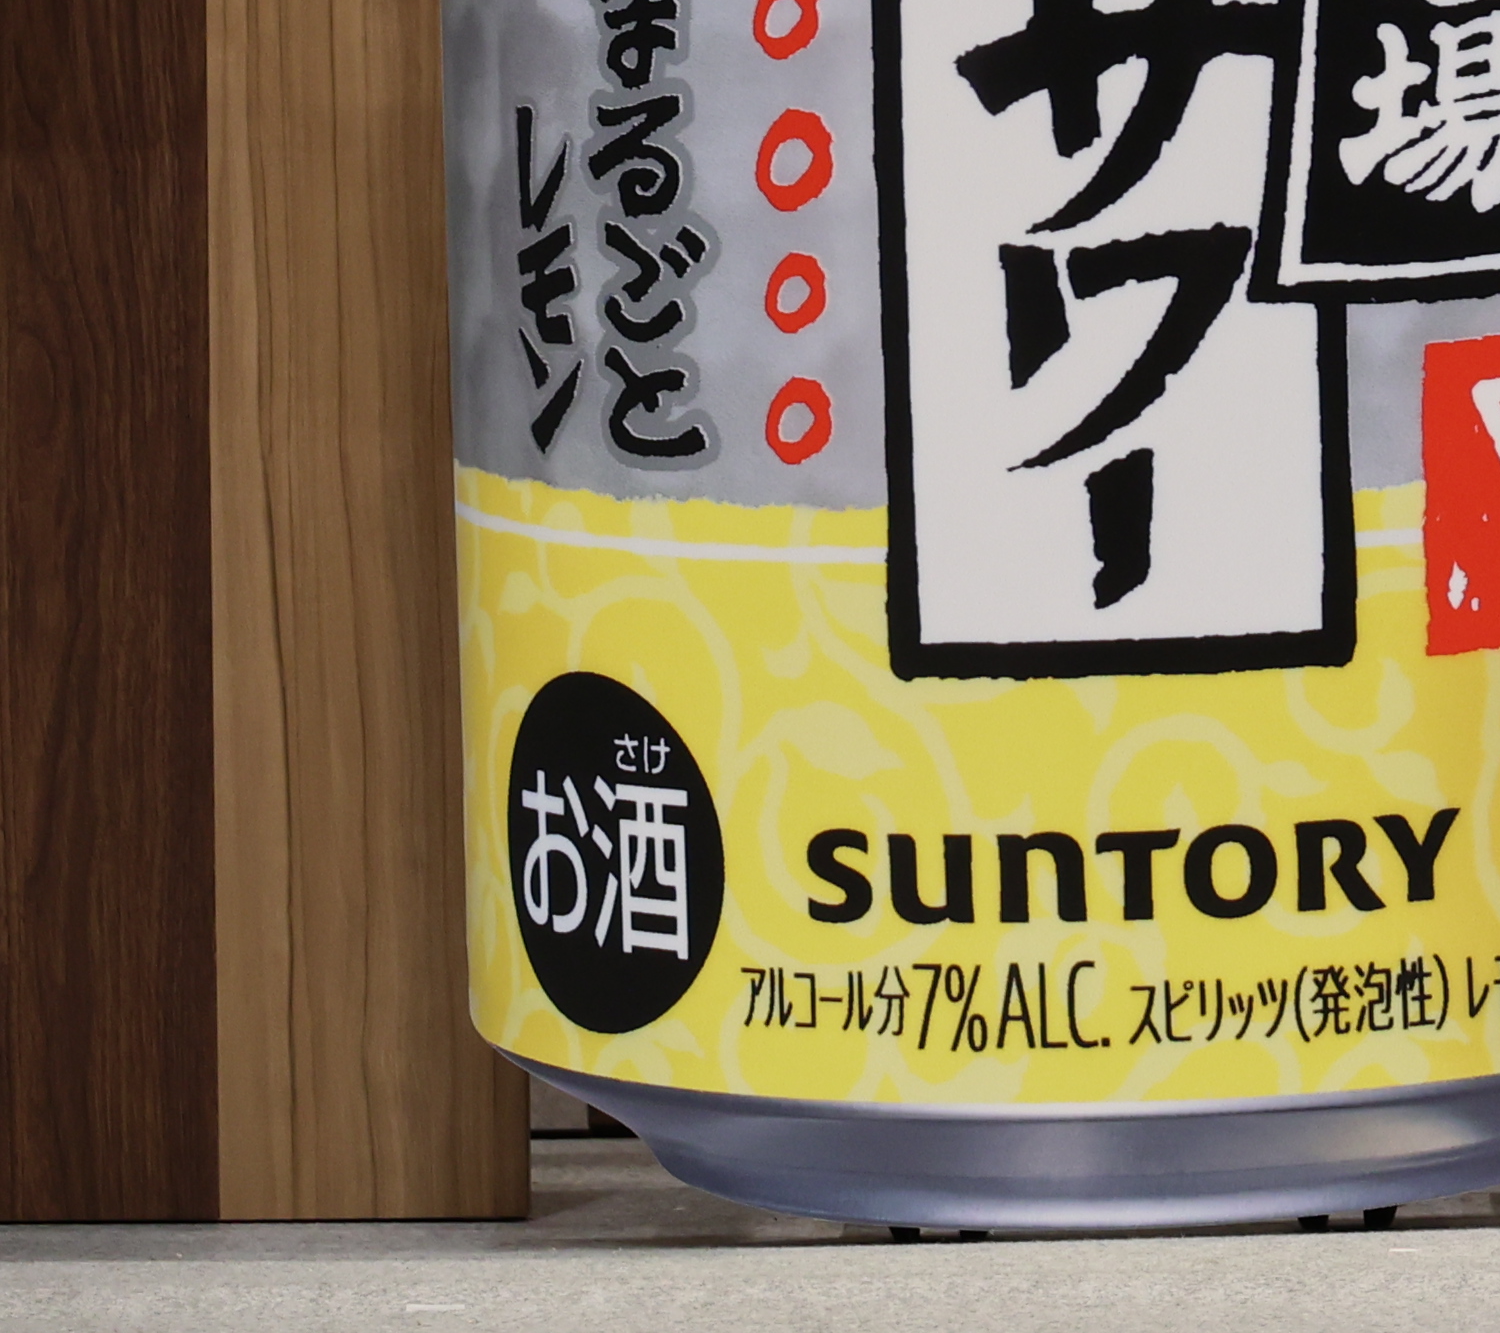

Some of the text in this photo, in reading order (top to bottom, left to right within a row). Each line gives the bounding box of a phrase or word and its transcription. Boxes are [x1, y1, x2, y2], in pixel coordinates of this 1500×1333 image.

[515, 105, 588, 455] レモン
[613, 732, 671, 775] さけ
[520, 770, 690, 963] お酒
[805, 807, 1462, 926] SUNTORY
[1128, 955, 1451, 1046] スピリッツ(発泡性)
